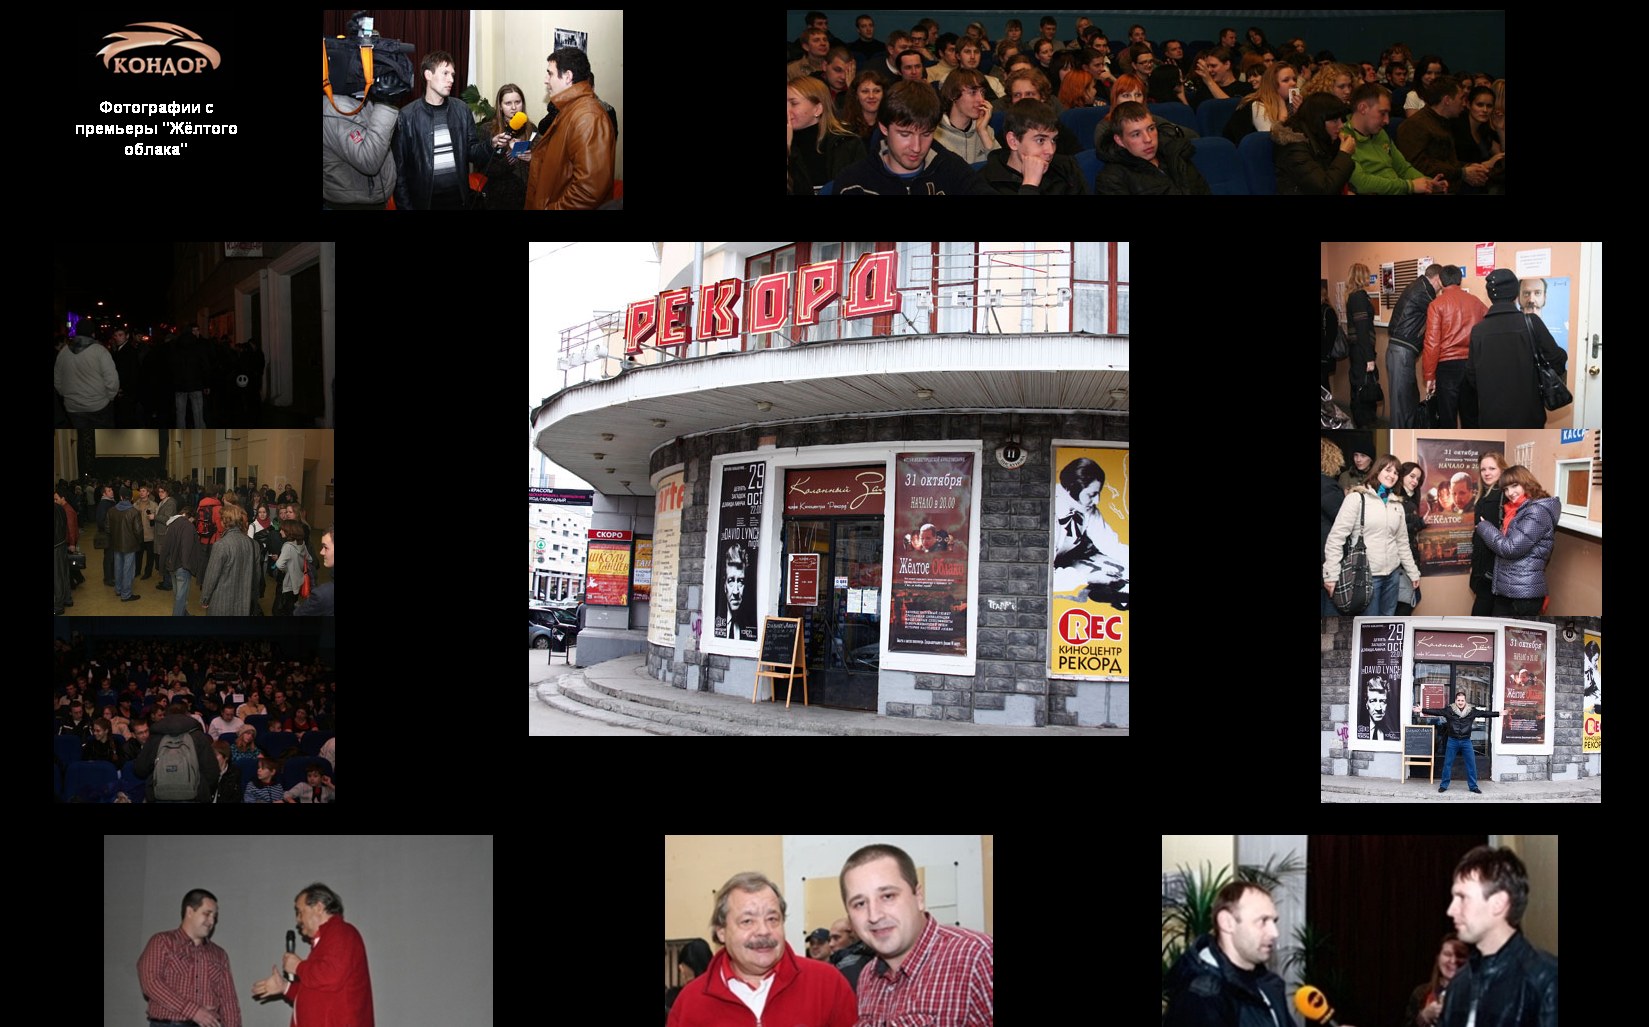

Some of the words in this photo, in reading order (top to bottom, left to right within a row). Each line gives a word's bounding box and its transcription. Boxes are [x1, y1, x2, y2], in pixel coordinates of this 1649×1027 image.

[624, 249, 902, 355] РЕКОРД
[747, 463, 766, 490] 29
[904, 473, 917, 486] 31
[920, 472, 963, 490] октября
[910, 496, 934, 509] НАЧАЛО
[596, 531, 623, 539] СКОРО
[724, 527, 741, 540] DAVID
[899, 557, 930, 575] Жёлтое
[1058, 607, 1123, 645] REC
[1387, 623, 1404, 641] 29
[1058, 645, 1123, 656] КИНОЦЕНТР
[1058, 656, 1122, 674] РЕКОРД
[1585, 717, 1601, 736] RE
